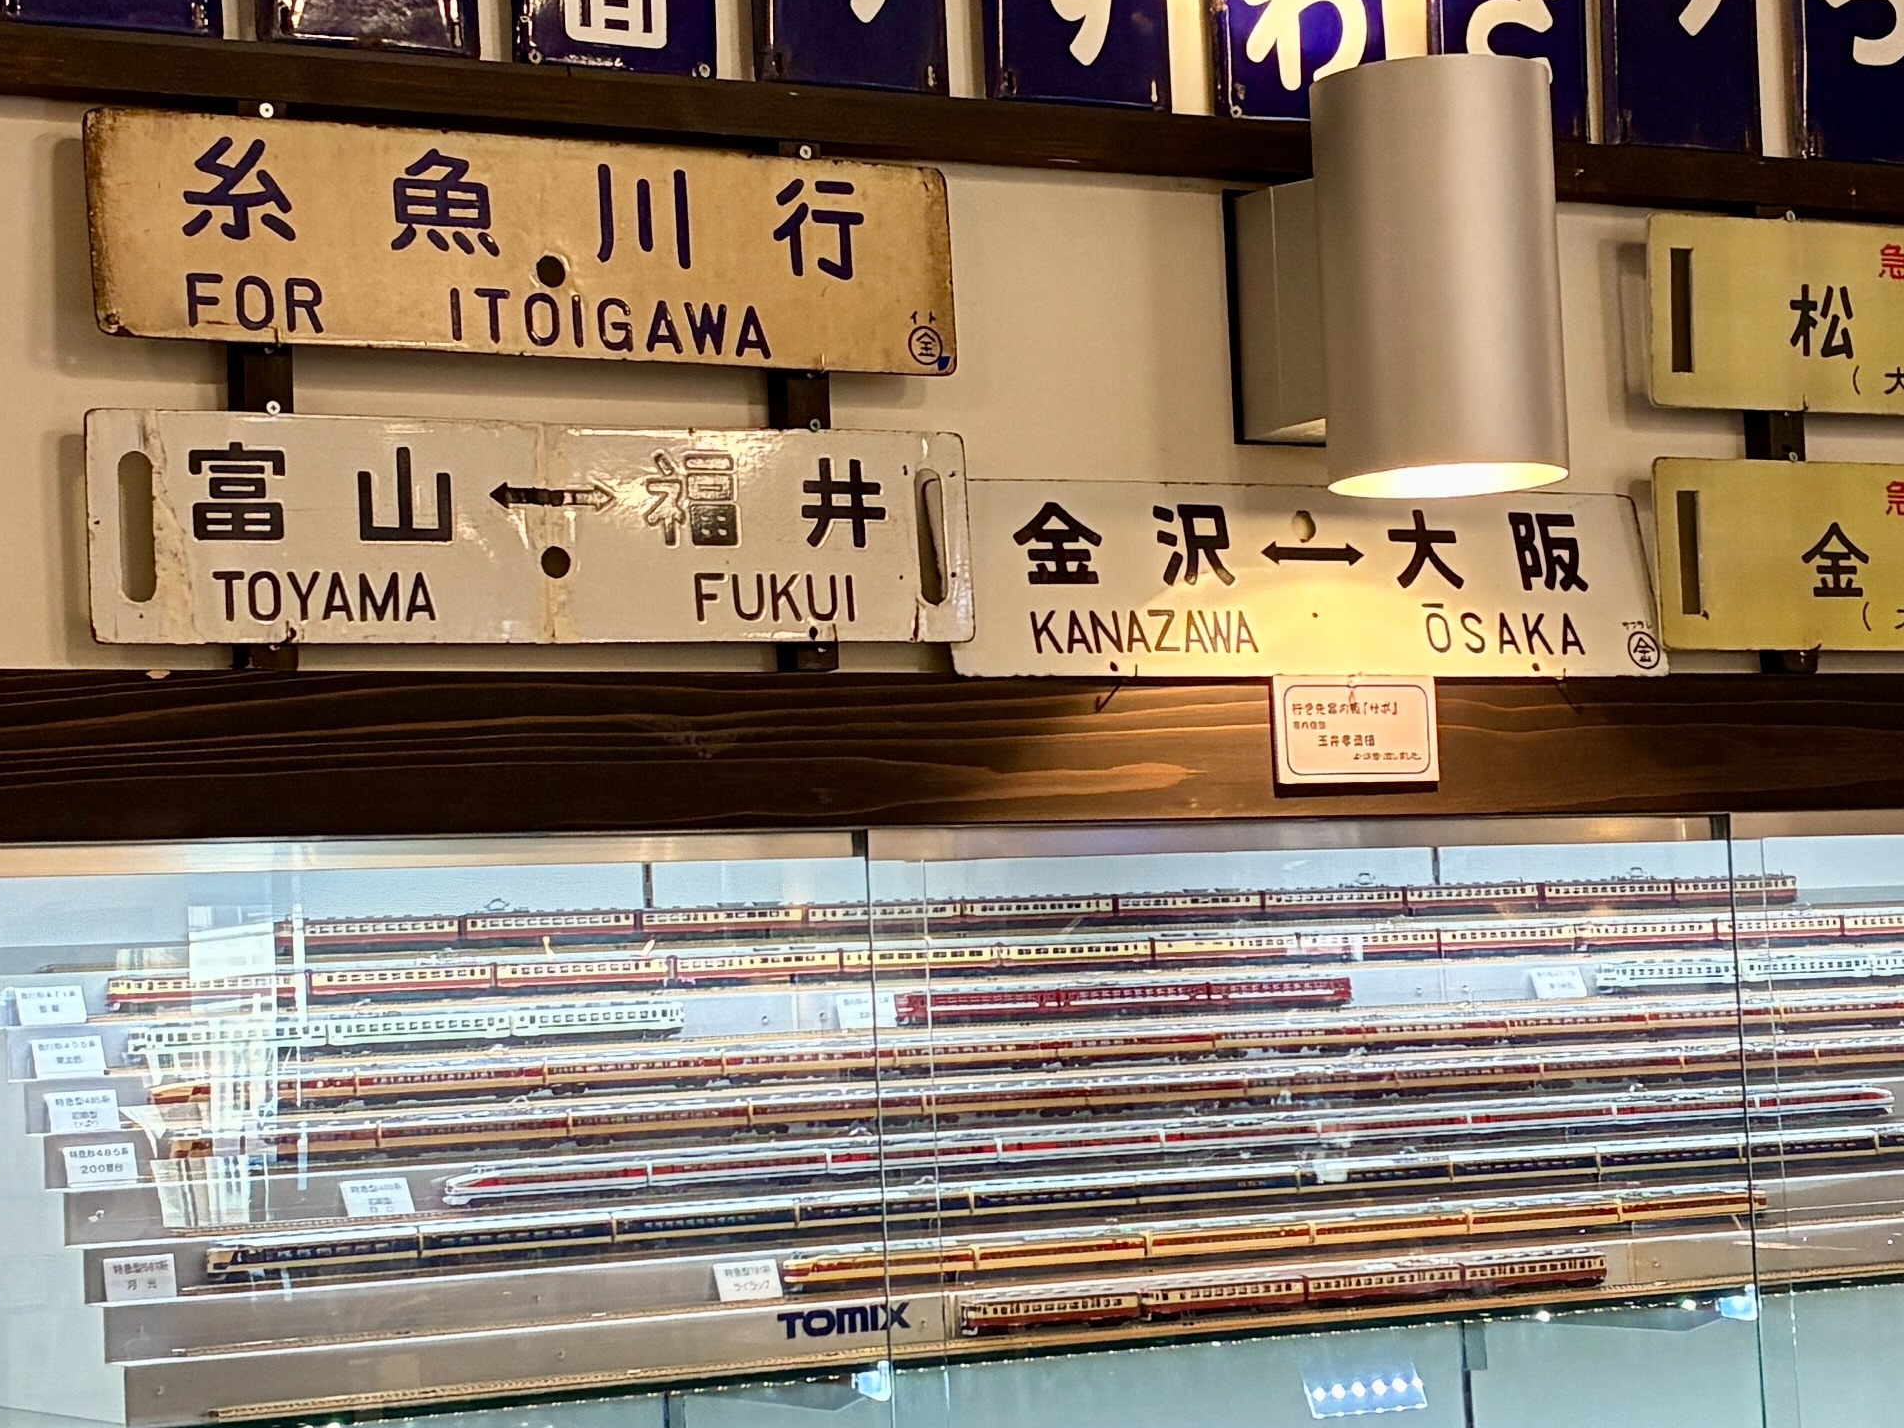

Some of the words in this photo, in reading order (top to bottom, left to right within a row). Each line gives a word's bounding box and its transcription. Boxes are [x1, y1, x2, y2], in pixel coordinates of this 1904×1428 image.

[181, 135, 867, 282] 糸魚川行
[185, 271, 326, 335] FOR
[448, 286, 773, 361] ITOIGAWA
[187, 441, 455, 544] 富山
[644, 449, 889, 550] 福井
[1012, 501, 1236, 588] 金沢
[1386, 508, 1590, 594] 大阪
[213, 568, 439, 625] TOYAMA
[694, 571, 858, 625] FUKUI
[1029, 608, 1261, 656] KANAZAWA
[1420, 602, 1586, 657] ŌSAKA
[777, 1301, 911, 1340] TOMIX
